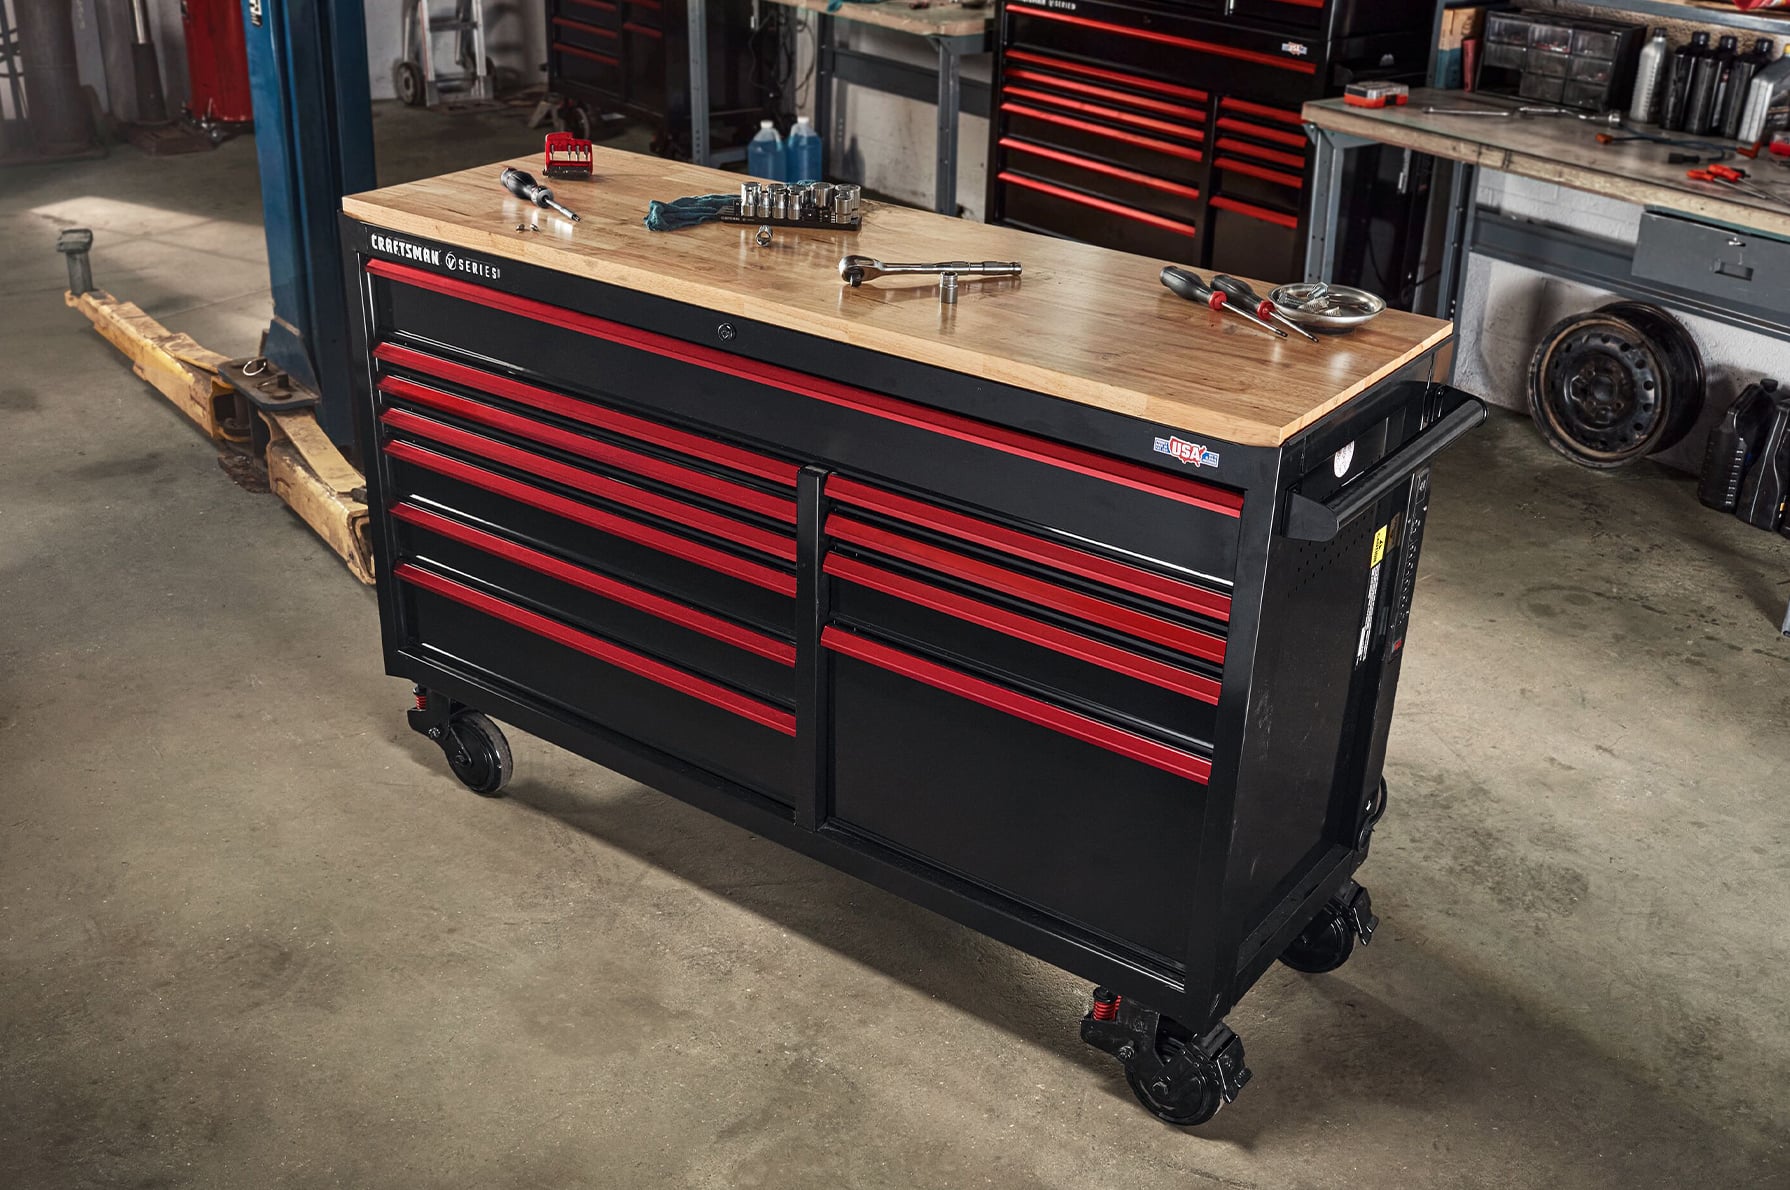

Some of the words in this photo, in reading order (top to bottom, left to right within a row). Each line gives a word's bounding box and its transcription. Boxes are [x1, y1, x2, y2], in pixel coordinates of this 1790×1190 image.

[371, 233, 440, 266] CRAFTSMAN
[458, 258, 497, 279] SERIES
[1172, 441, 1201, 461] USA
